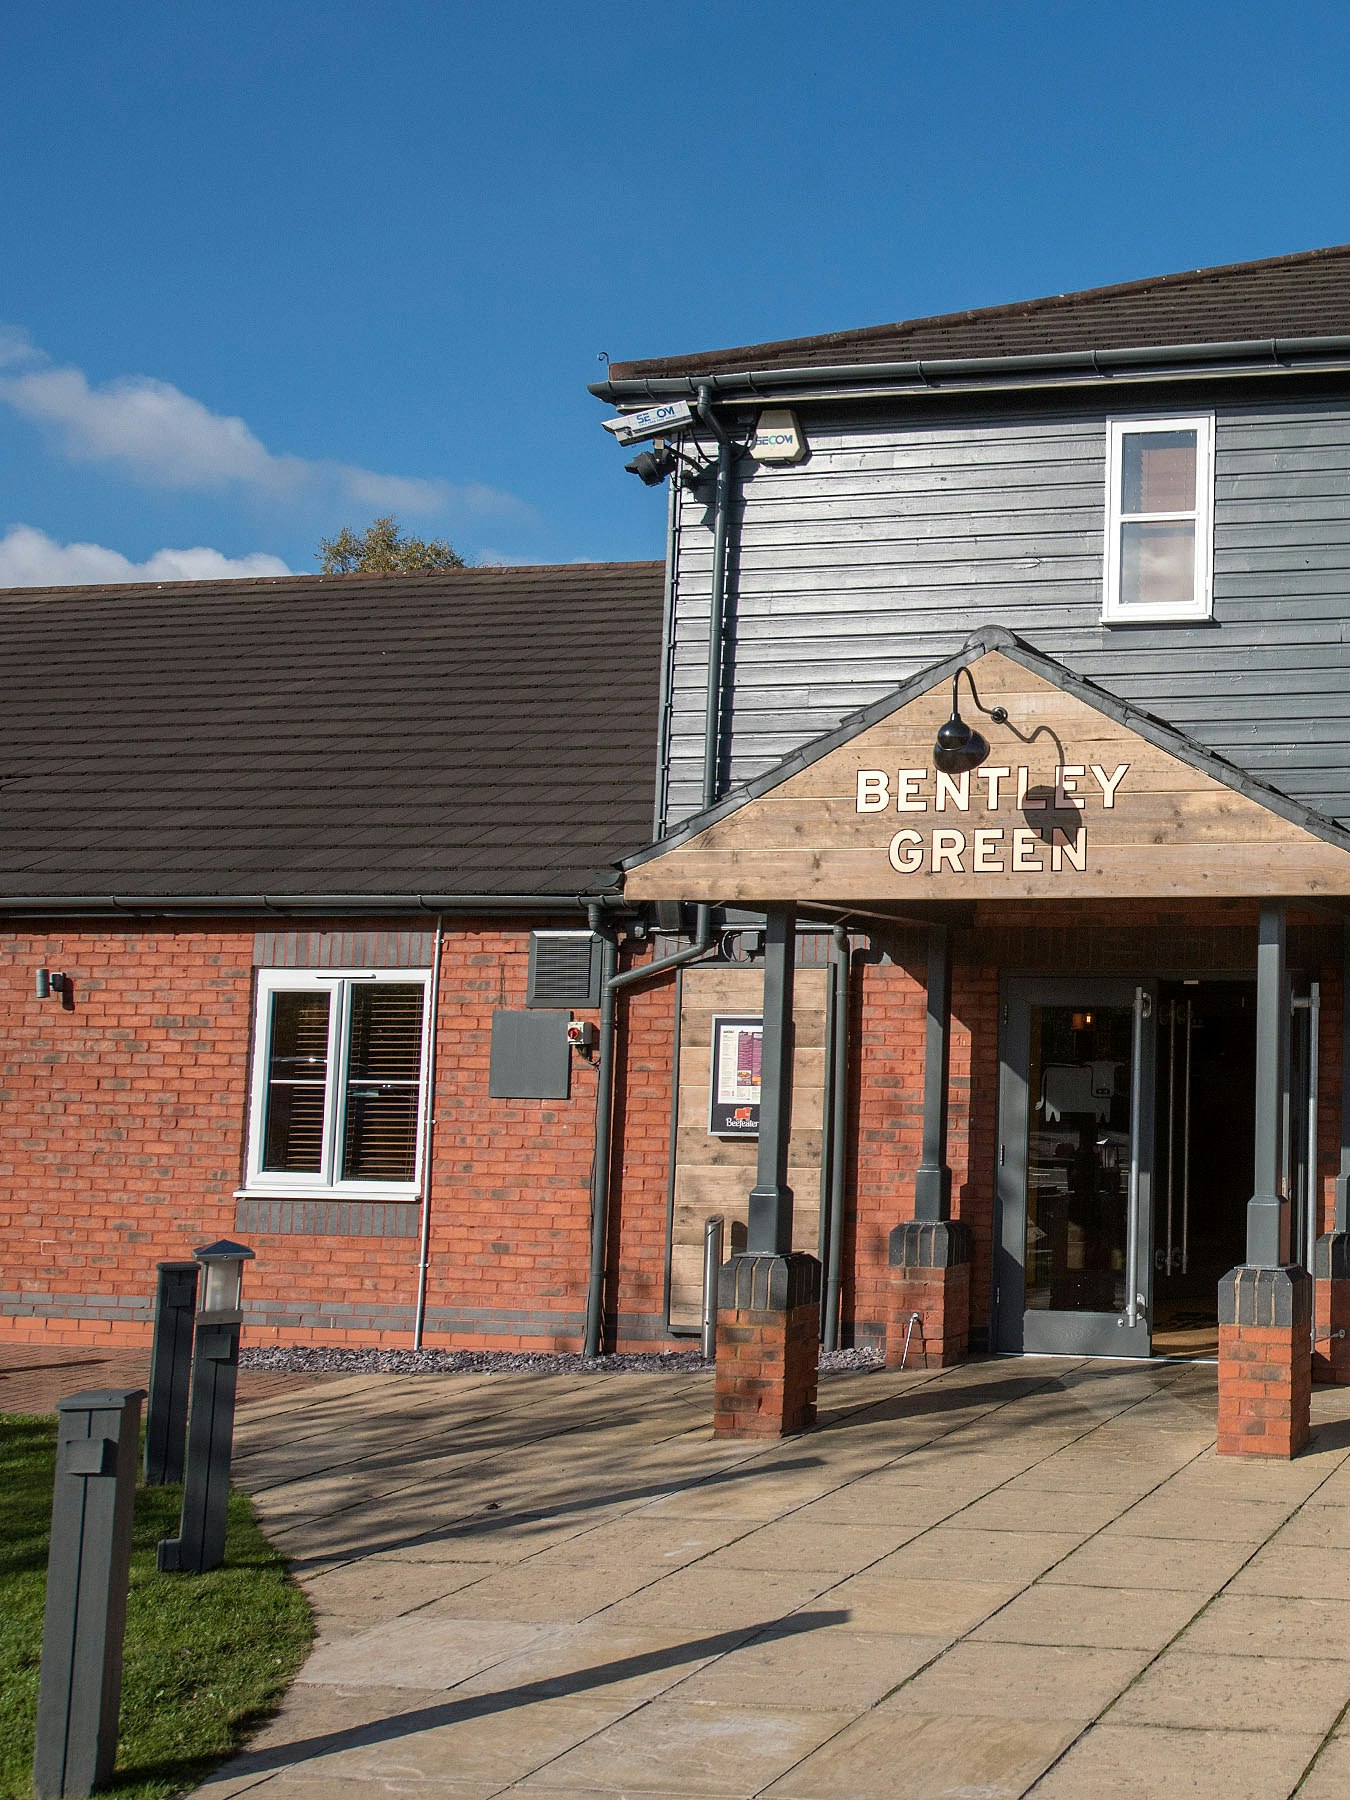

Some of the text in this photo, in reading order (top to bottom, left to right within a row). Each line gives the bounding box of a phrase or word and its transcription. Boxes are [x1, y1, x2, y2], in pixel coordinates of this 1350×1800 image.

[636, 406, 675, 424] SEOM
[755, 434, 793, 446] SECOM
[856, 763, 1131, 813] BENTLEY
[888, 828, 1087, 873] GREEN
[725, 1117, 760, 1129] Beefeater
